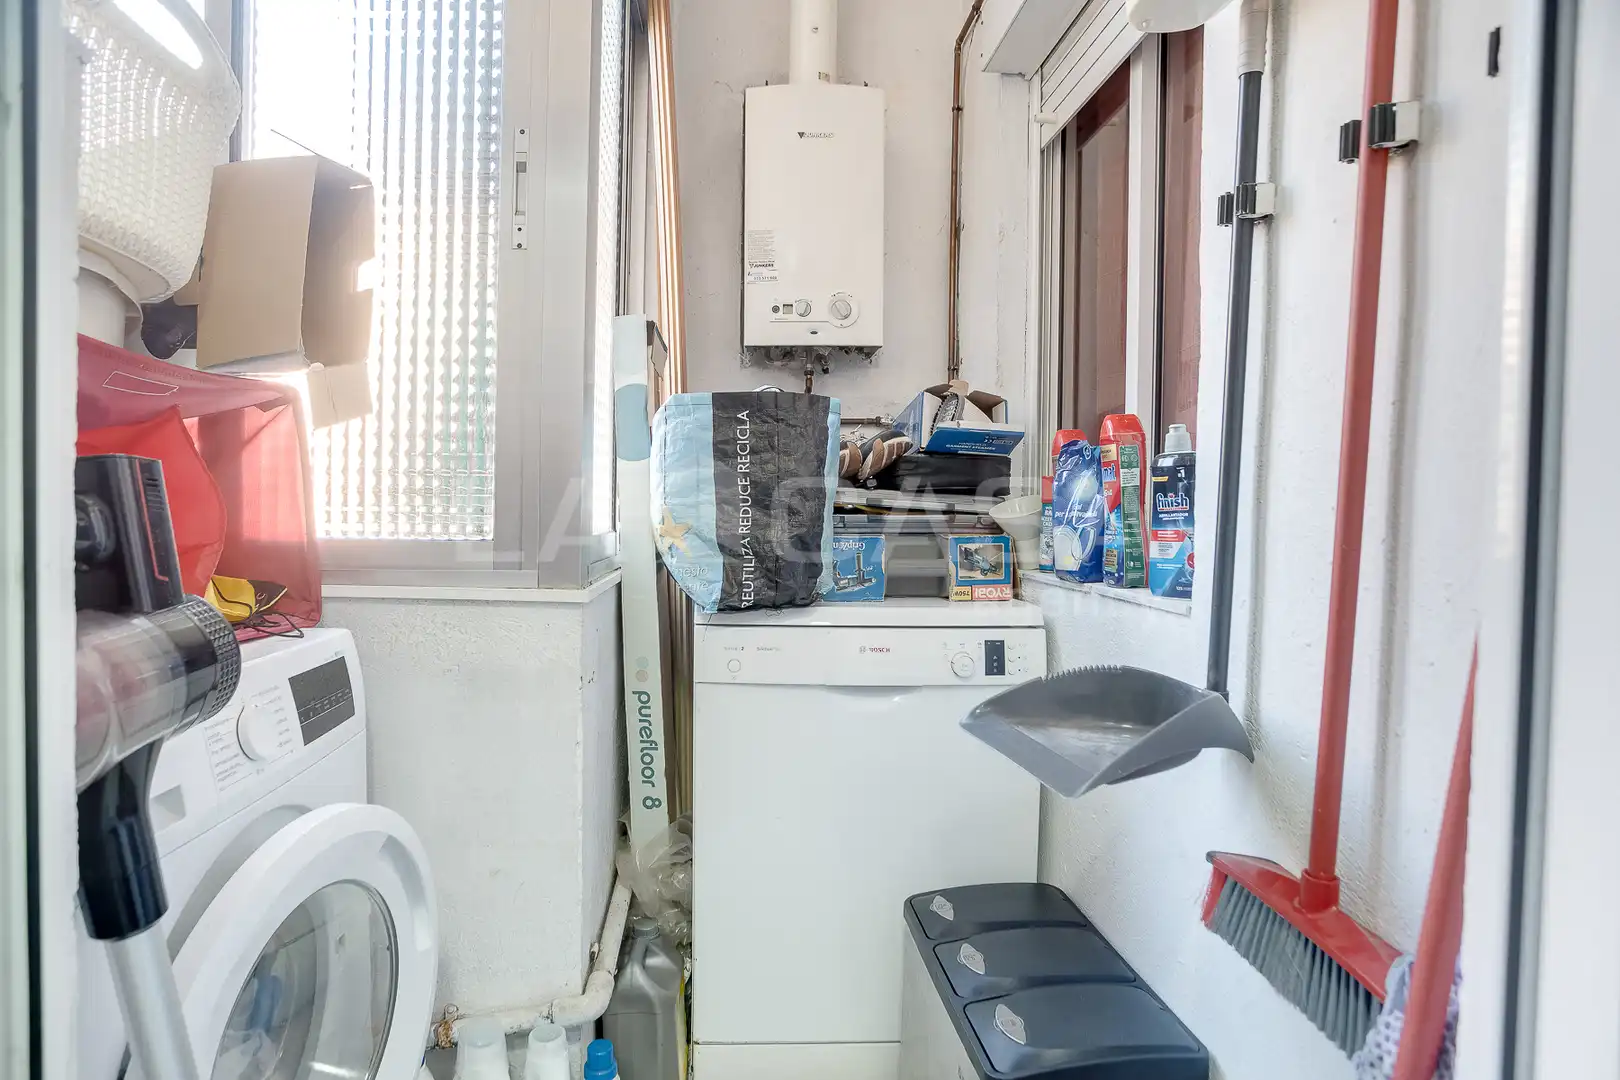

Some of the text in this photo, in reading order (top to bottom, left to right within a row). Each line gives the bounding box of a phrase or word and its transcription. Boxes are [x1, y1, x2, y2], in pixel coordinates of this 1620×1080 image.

[736, 409, 756, 609] REUTILIZA REDUCE RECICLA
[1157, 493, 1189, 509] finish
[975, 587, 1011, 599] RYOBI
[631, 690, 663, 810] purefloor 8
